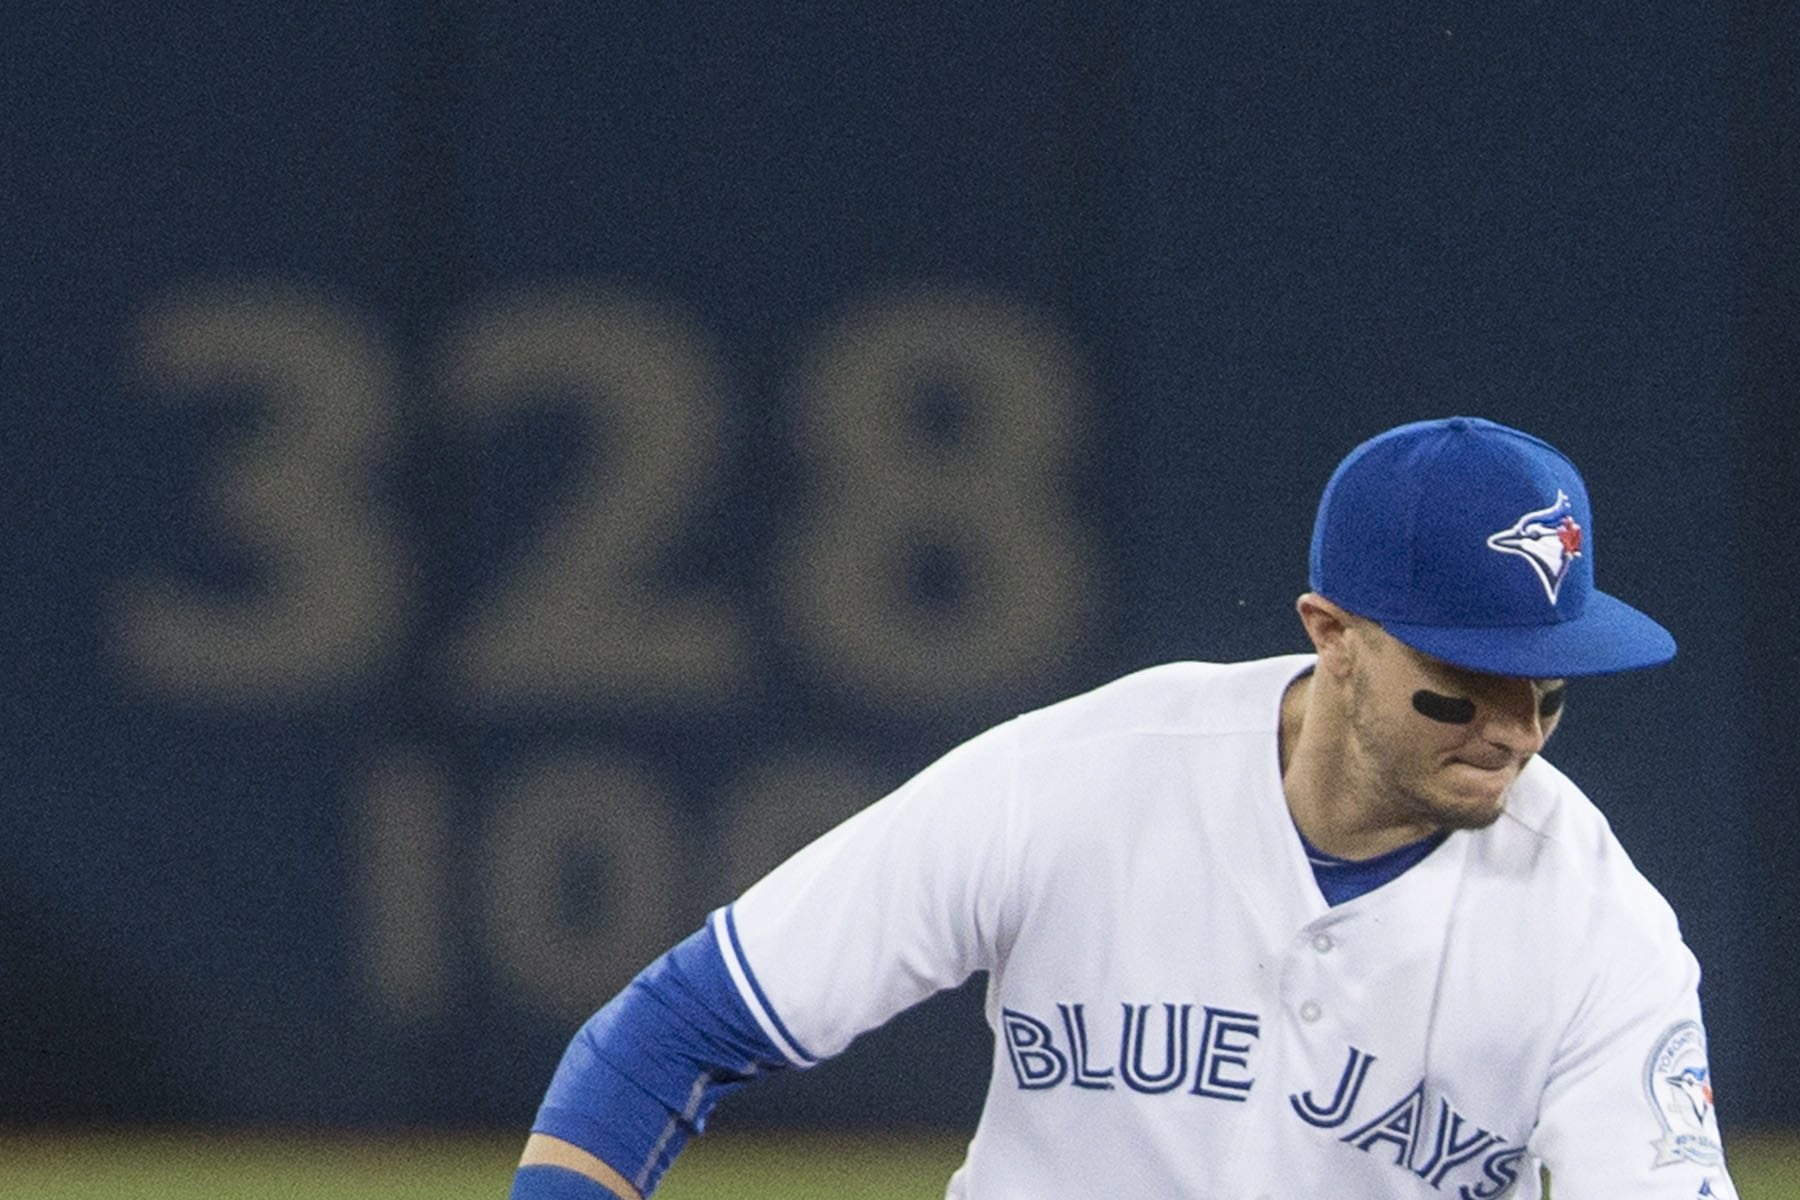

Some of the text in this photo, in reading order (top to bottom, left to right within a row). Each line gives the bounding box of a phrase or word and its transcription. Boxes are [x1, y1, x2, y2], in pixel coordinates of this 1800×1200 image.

[118, 284, 1098, 710] 328
[352, 750, 885, 1020] 10
[1002, 1002, 1260, 1102] BLUE
